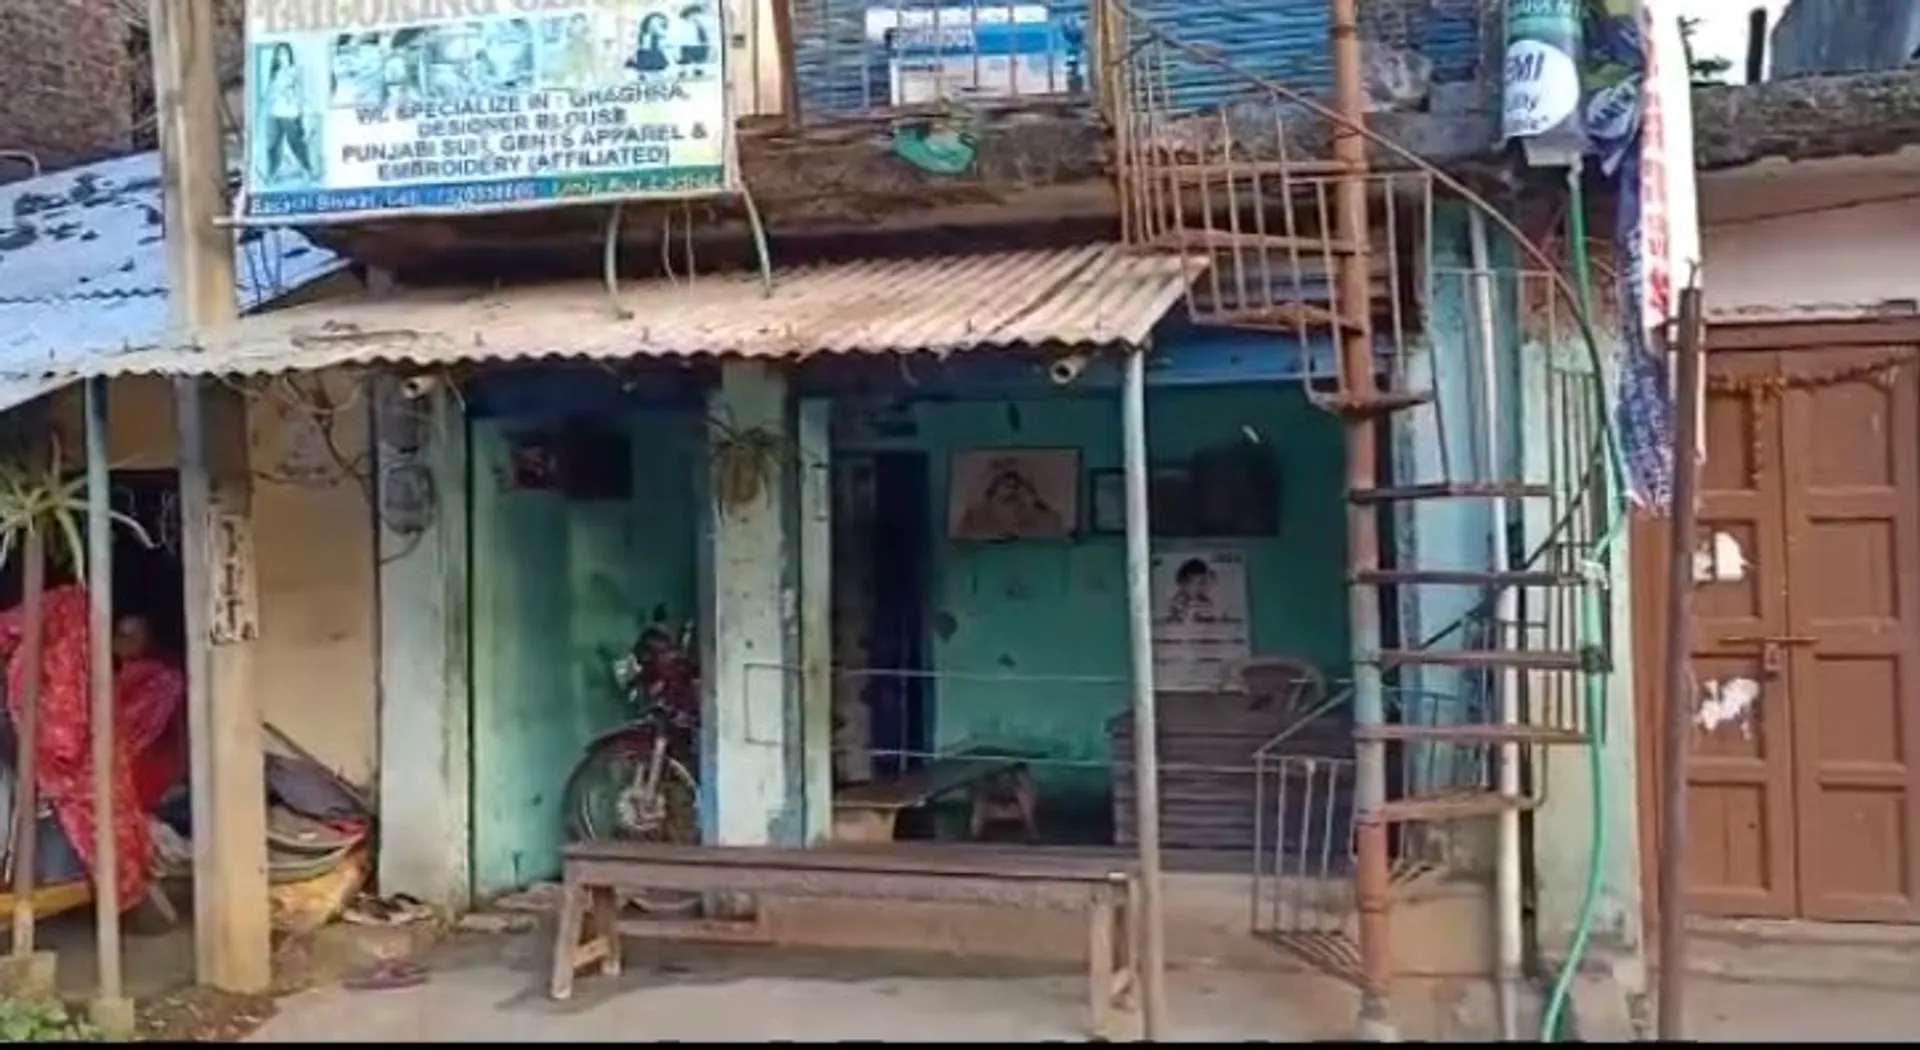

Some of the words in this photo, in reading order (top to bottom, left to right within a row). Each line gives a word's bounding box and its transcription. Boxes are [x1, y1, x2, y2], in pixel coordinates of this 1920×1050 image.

[417, 115, 529, 139] DESIGNER
[535, 106, 626, 131] BLOUSE
[342, 139, 436, 164] PUNJABI
[581, 123, 685, 147] APPAREL
[690, 121, 708, 140] &
[377, 156, 521, 182] EMBROIDERY
[528, 145, 671, 171] (AFFILIATED)
